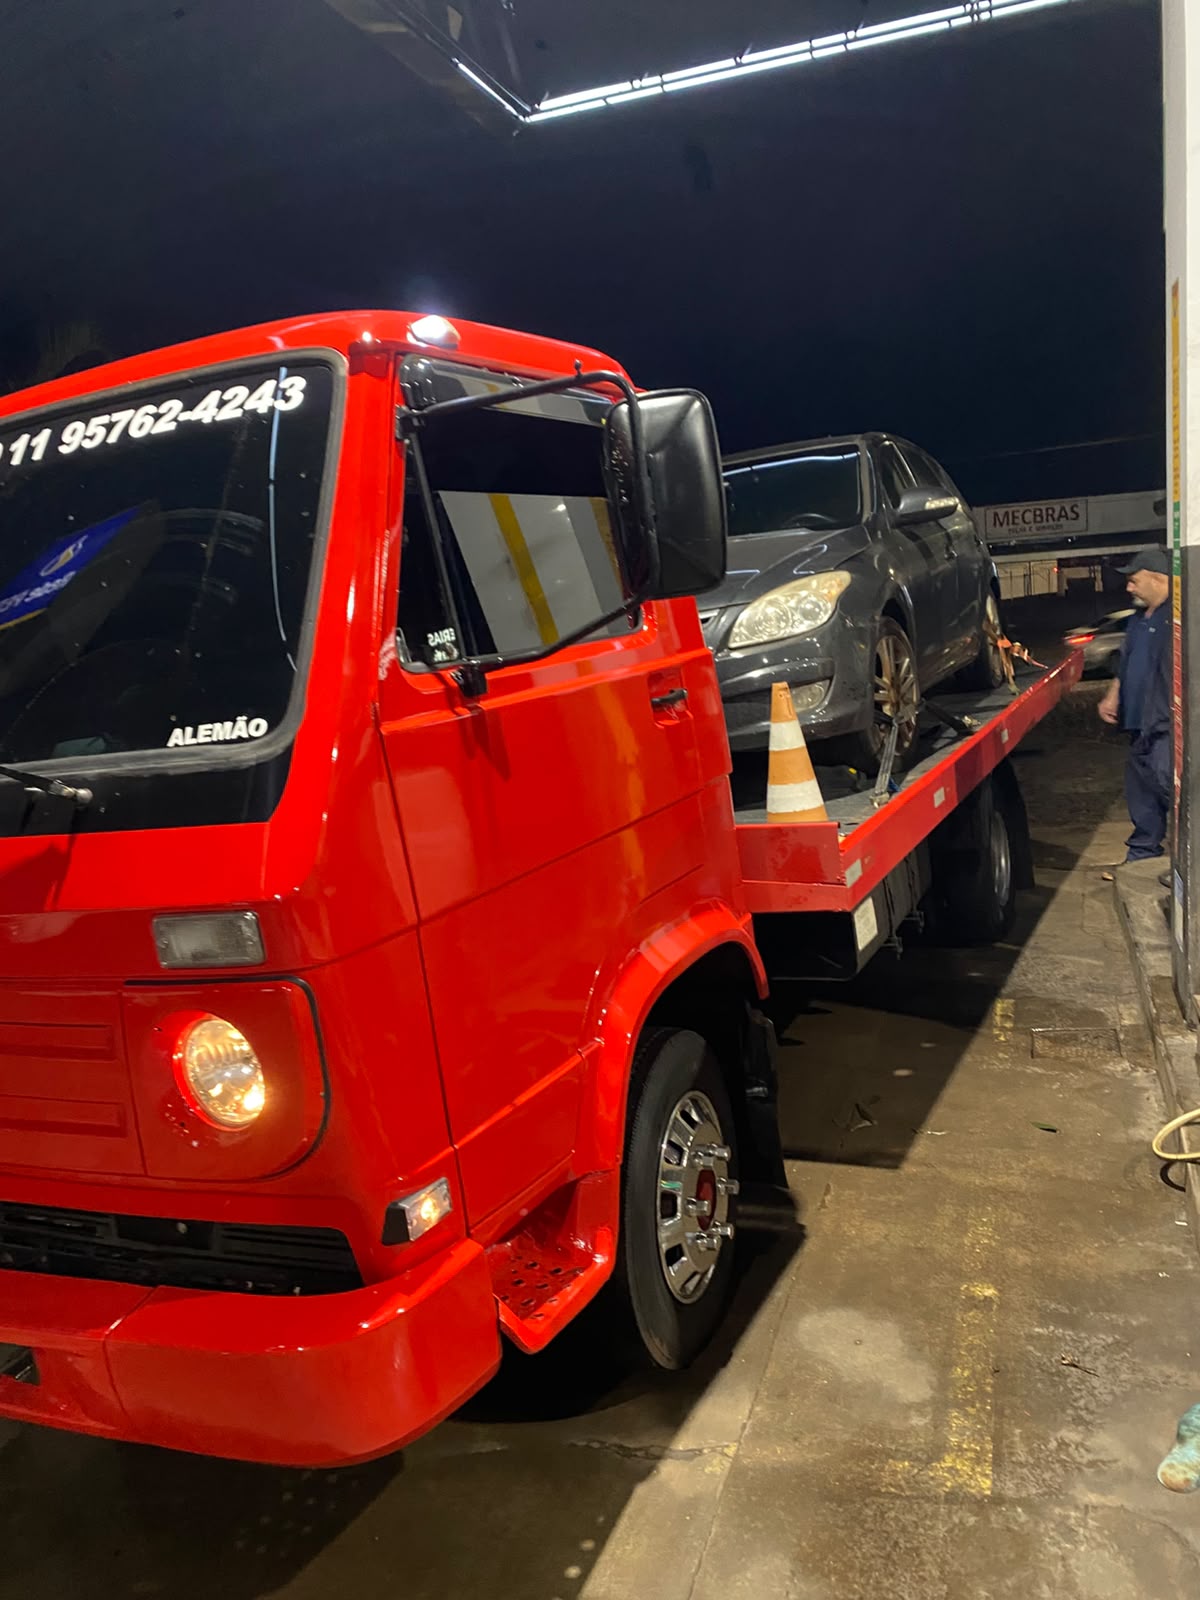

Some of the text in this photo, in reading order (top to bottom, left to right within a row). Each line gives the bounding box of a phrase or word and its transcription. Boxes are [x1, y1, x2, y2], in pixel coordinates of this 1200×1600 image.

[9, 428, 52, 466] 11
[57, 375, 307, 455] 95762-4243
[992, 504, 1080, 528] MECBRAS
[166, 716, 269, 748] ALEMÃO
